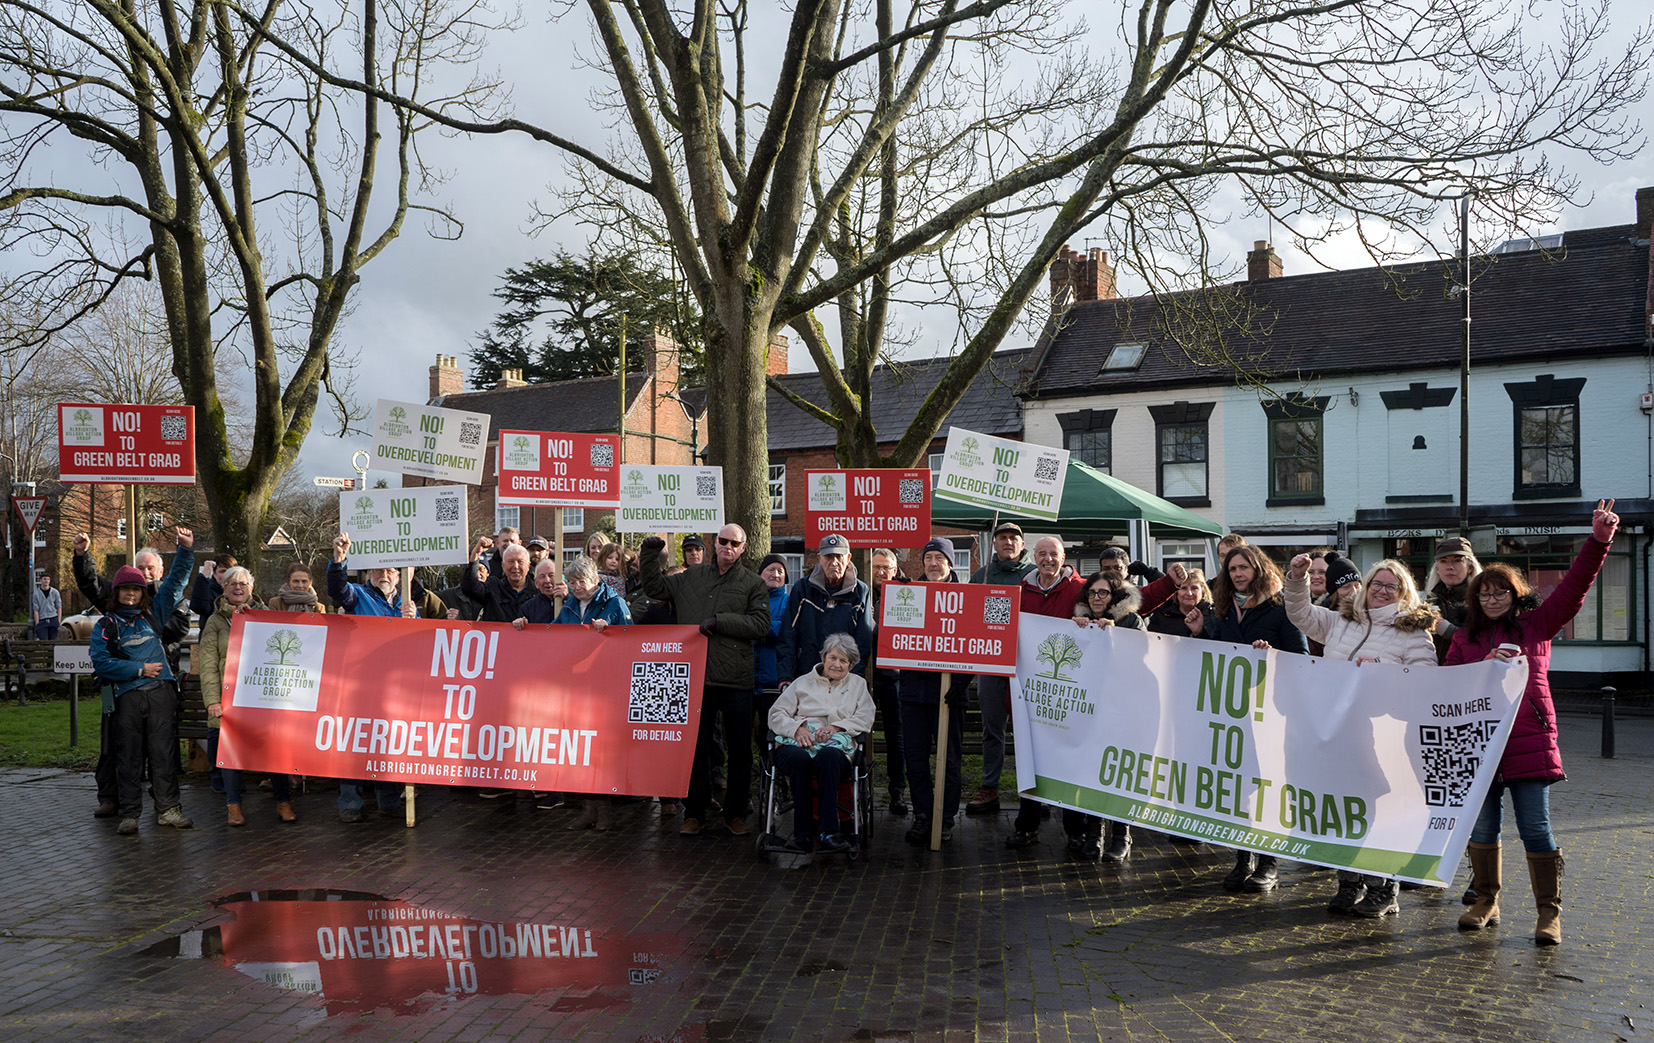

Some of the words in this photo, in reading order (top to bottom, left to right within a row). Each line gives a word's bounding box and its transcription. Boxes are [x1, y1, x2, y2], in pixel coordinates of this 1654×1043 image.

[112, 412, 141, 432] NO!
[420, 415, 444, 434] NO!
[119, 436, 135, 450] TO
[424, 436, 436, 450] TO
[548, 439, 573, 458] NO!
[74, 452, 113, 467] GREEN
[117, 453, 146, 467] BELT
[149, 454, 180, 468] GRAB
[378, 445, 477, 470] OVERDEVELOPMENT
[992, 447, 1019, 468] NO!
[553, 462, 567, 476] TO
[996, 469, 1009, 483] TO
[512, 476, 547, 490] GREEN
[550, 478, 576, 491] BELT
[579, 479, 607, 493] GRAB
[658, 474, 680, 491] NO!
[854, 476, 880, 496] NO!
[946, 474, 1053, 507] OVERDEVELOPMENT
[20, 502, 39, 510] GIVE
[390, 498, 416, 518] NO!
[664, 494, 676, 506] TO
[860, 500, 874, 514] TO
[622, 508, 717, 520] OVERDEVELOPMENT
[396, 522, 411, 536] TO
[818, 517, 854, 531] GREEN
[858, 517, 884, 531] BELT
[887, 517, 917, 531] GRAB
[1388, 529, 1421, 537] BOOKS
[349, 536, 459, 555] OVERDEVELOPMENT
[934, 591, 964, 614] NO!
[940, 618, 955, 634] TO
[641, 642, 661, 653] SCAN
[662, 643, 682, 653] HERE
[892, 634, 932, 652] GREEN
[935, 636, 966, 653] BELT
[968, 638, 1002, 655] GRAB
[430, 628, 499, 680] NO!
[56, 661, 75, 669] Keep
[253, 667, 307, 678] ALBRIGHTON
[244, 676, 279, 686] VILLAGE
[282, 679, 314, 688] ACTION
[1025, 678, 1087, 700] ALBRIGHTON
[1196, 651, 1267, 722] NO!
[263, 687, 292, 697] GROUP
[443, 684, 476, 720] TO
[1022, 690, 1052, 707] LLAGE
[1056, 698, 1094, 715] ACTION
[1432, 703, 1462, 718] SCAN
[1465, 697, 1492, 715] HERE
[1036, 705, 1067, 722] GROUP
[315, 715, 598, 767] OVERDEVELOPMENT
[632, 730, 648, 740] FOR
[650, 730, 682, 741] DETAILS
[1209, 721, 1244, 770] TO
[366, 760, 537, 781] ALBRIGHTONGREENBELT.CO.UK
[1099, 745, 1187, 805] GREEN
[1195, 766, 1272, 823] BELT
[1279, 783, 1368, 840] GRAB
[1128, 804, 1311, 855] ALBRIGHTONGREENBELT.CO.UK
[1429, 817, 1447, 830] FOR
